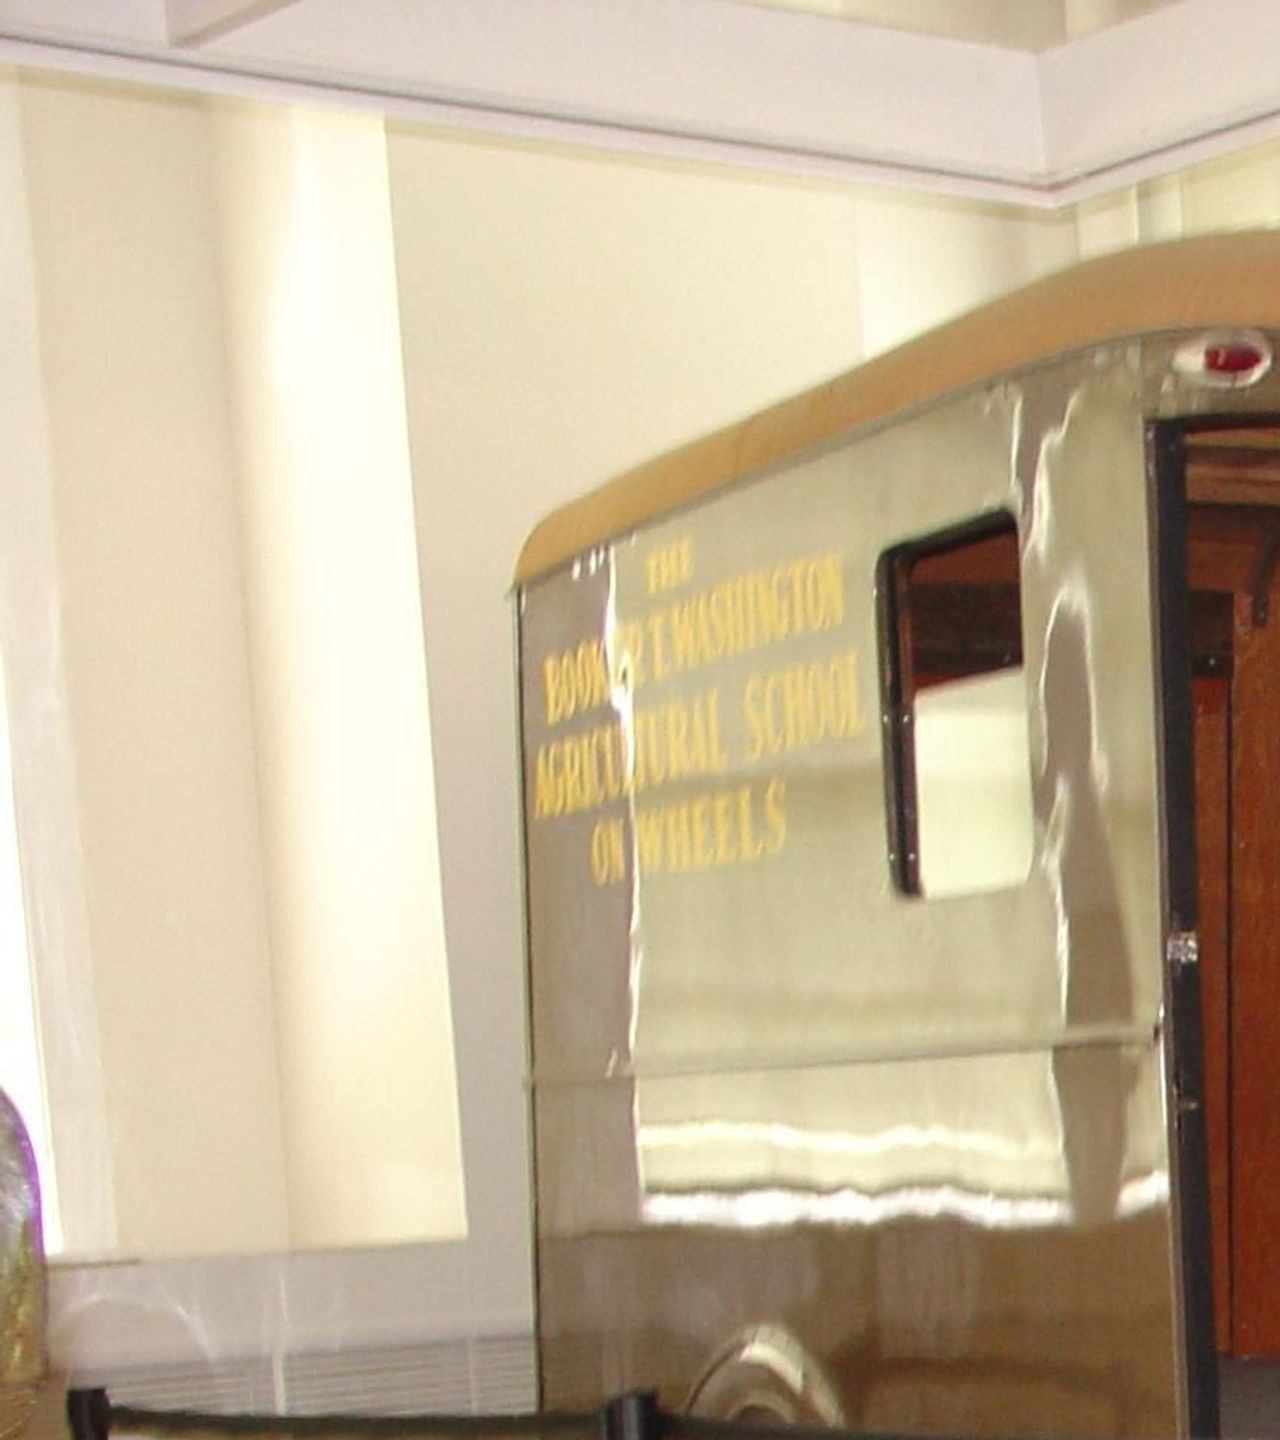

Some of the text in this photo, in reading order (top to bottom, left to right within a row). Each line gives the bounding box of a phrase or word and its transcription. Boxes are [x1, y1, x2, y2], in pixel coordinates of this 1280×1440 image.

[542, 619, 646, 726] BOOKR
[742, 650, 867, 762] SCHOOL
[590, 778, 788, 886] ON WHEELS
